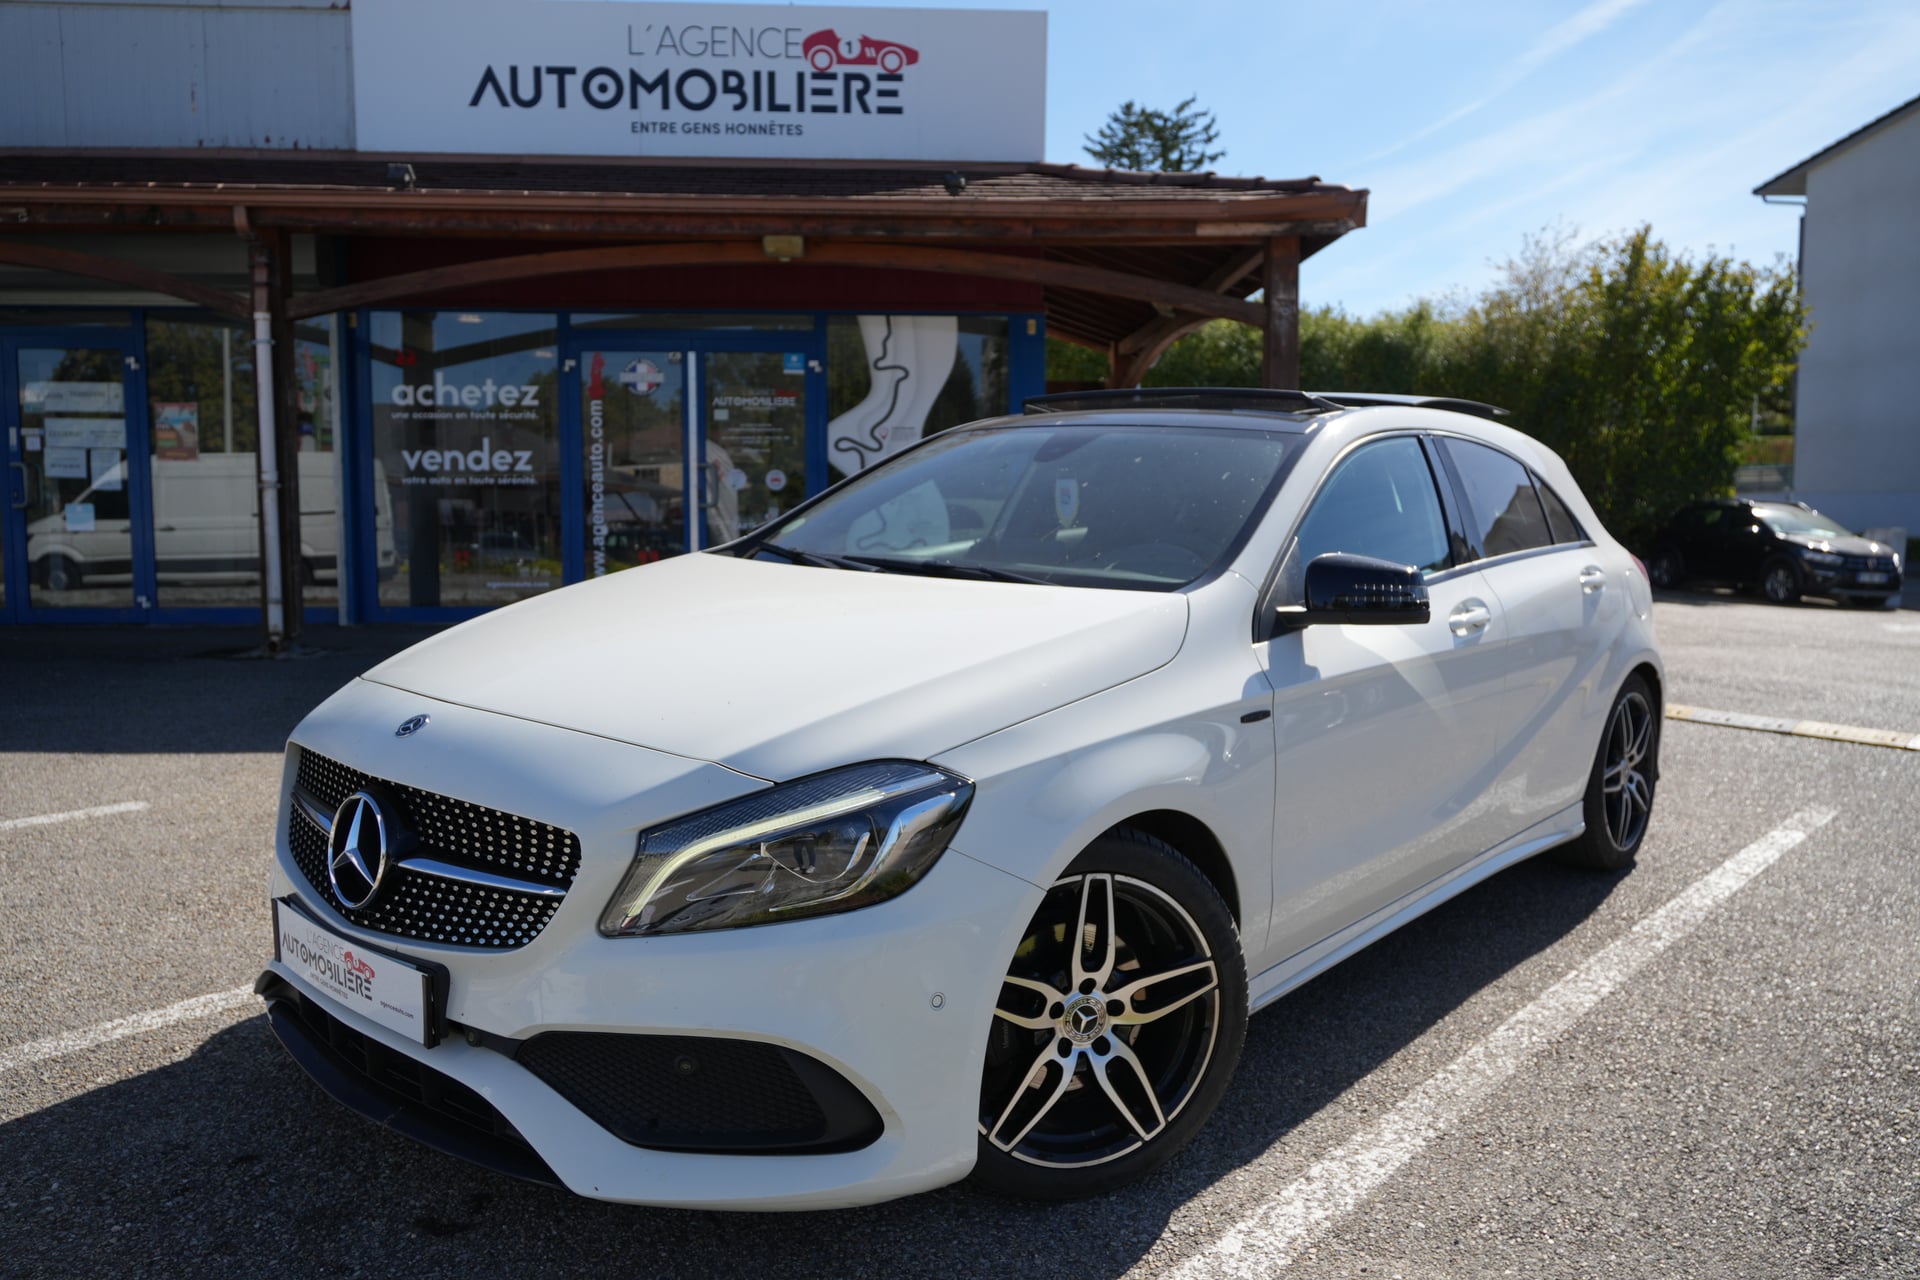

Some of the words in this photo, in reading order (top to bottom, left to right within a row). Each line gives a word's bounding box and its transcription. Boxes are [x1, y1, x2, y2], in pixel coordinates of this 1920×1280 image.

[627, 23, 803, 59] L'AGENCE
[468, 63, 904, 115] AUTOMOBILIERE
[631, 121, 677, 134] ENTRE
[681, 122, 721, 135] GENS
[726, 120, 803, 136] HONNÊTES
[391, 371, 540, 406] achetez
[391, 411, 409, 420] une
[412, 409, 453, 420] occasion
[455, 411, 468, 420] en
[470, 410, 496, 420] toute
[401, 436, 533, 472] vendez
[401, 475, 427, 485] votre
[429, 476, 452, 485] auto
[454, 476, 467, 485] en
[469, 475, 495, 485] toute
[589, 400, 608, 577] ww.agenceauto.com
[282, 930, 373, 1001] AUTOMOBILIERE
